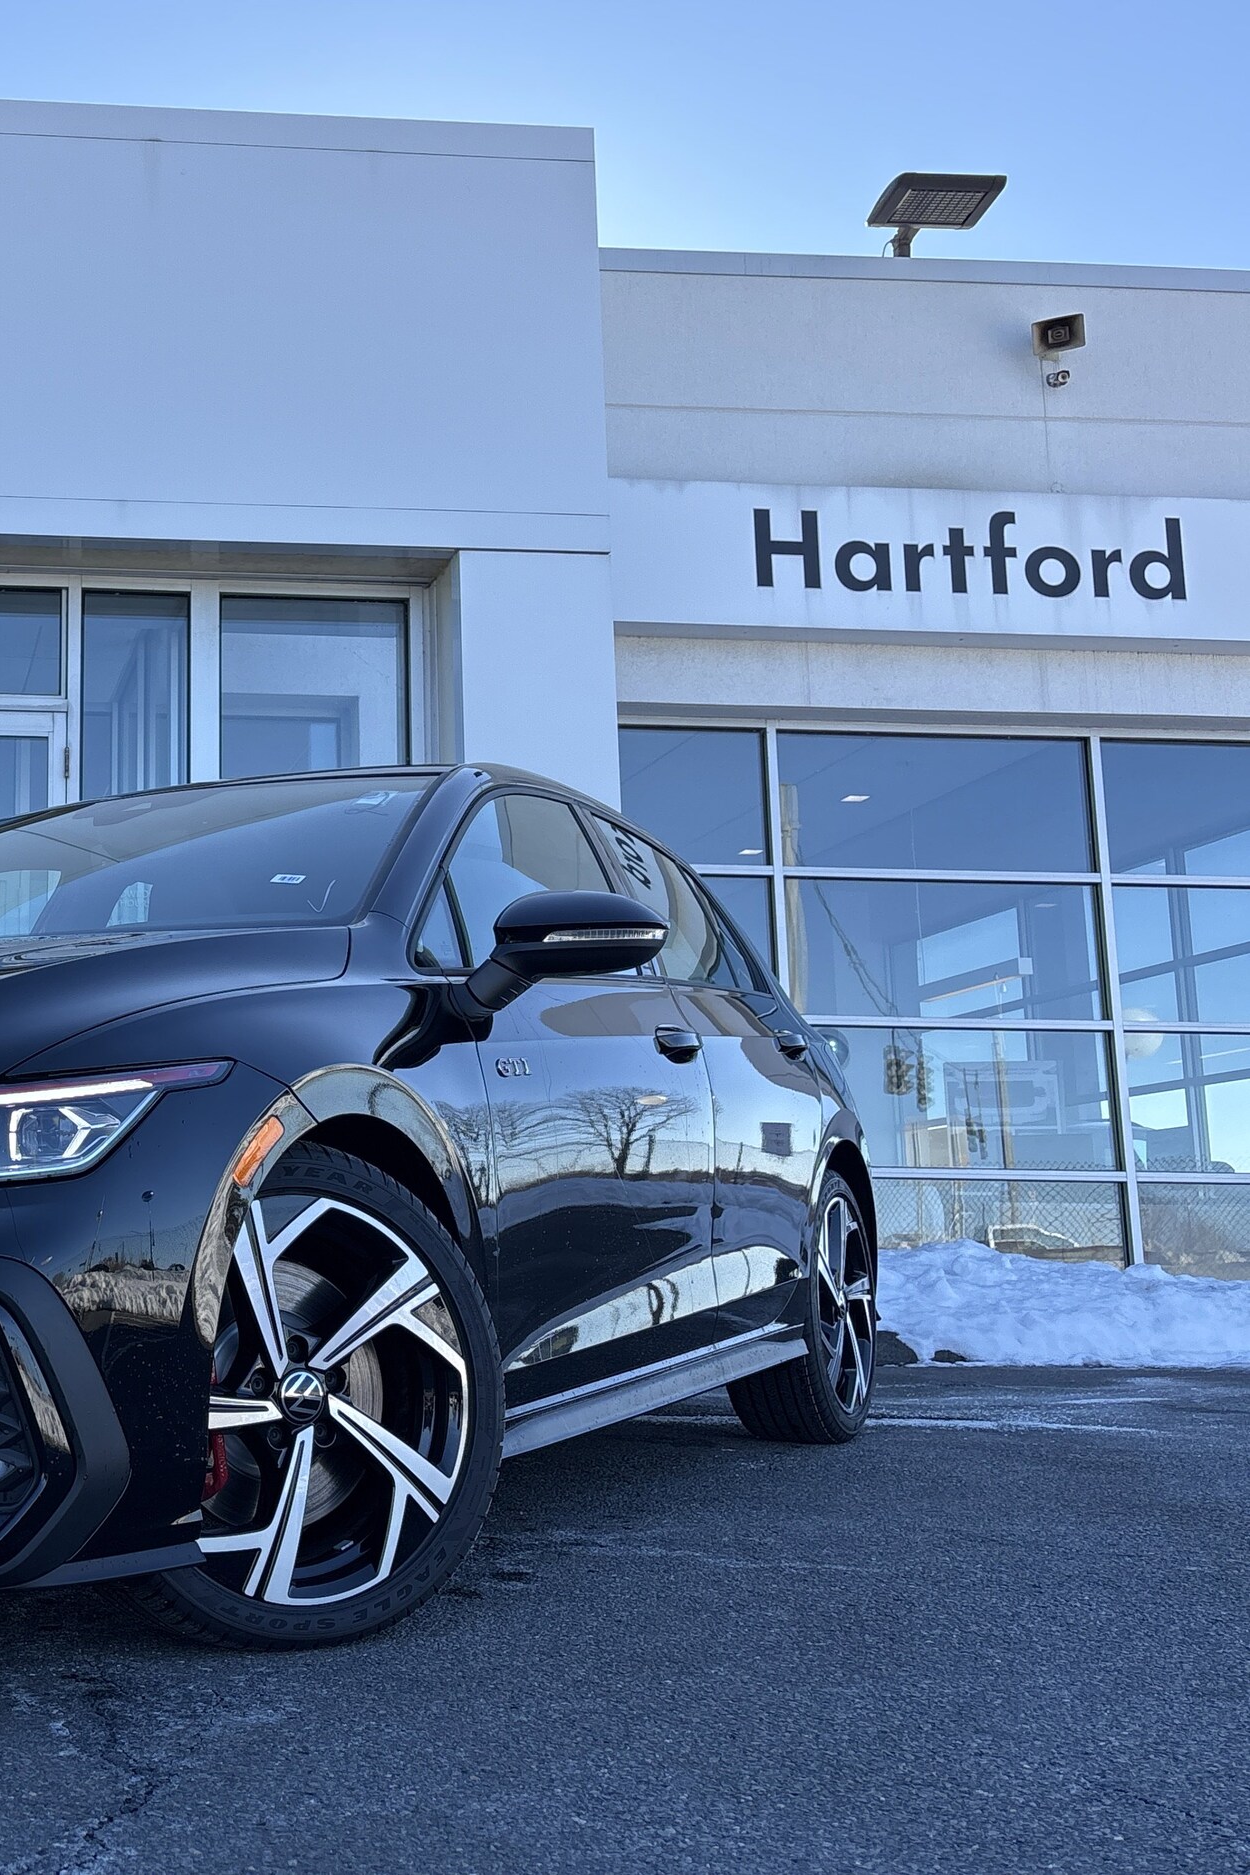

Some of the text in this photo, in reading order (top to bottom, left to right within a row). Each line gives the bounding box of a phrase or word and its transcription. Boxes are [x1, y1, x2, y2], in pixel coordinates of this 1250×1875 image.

[753, 508, 1187, 600] Hartford
[495, 1058, 532, 1078] GTI
[219, 1546, 448, 1631] EAGLE SPORT
